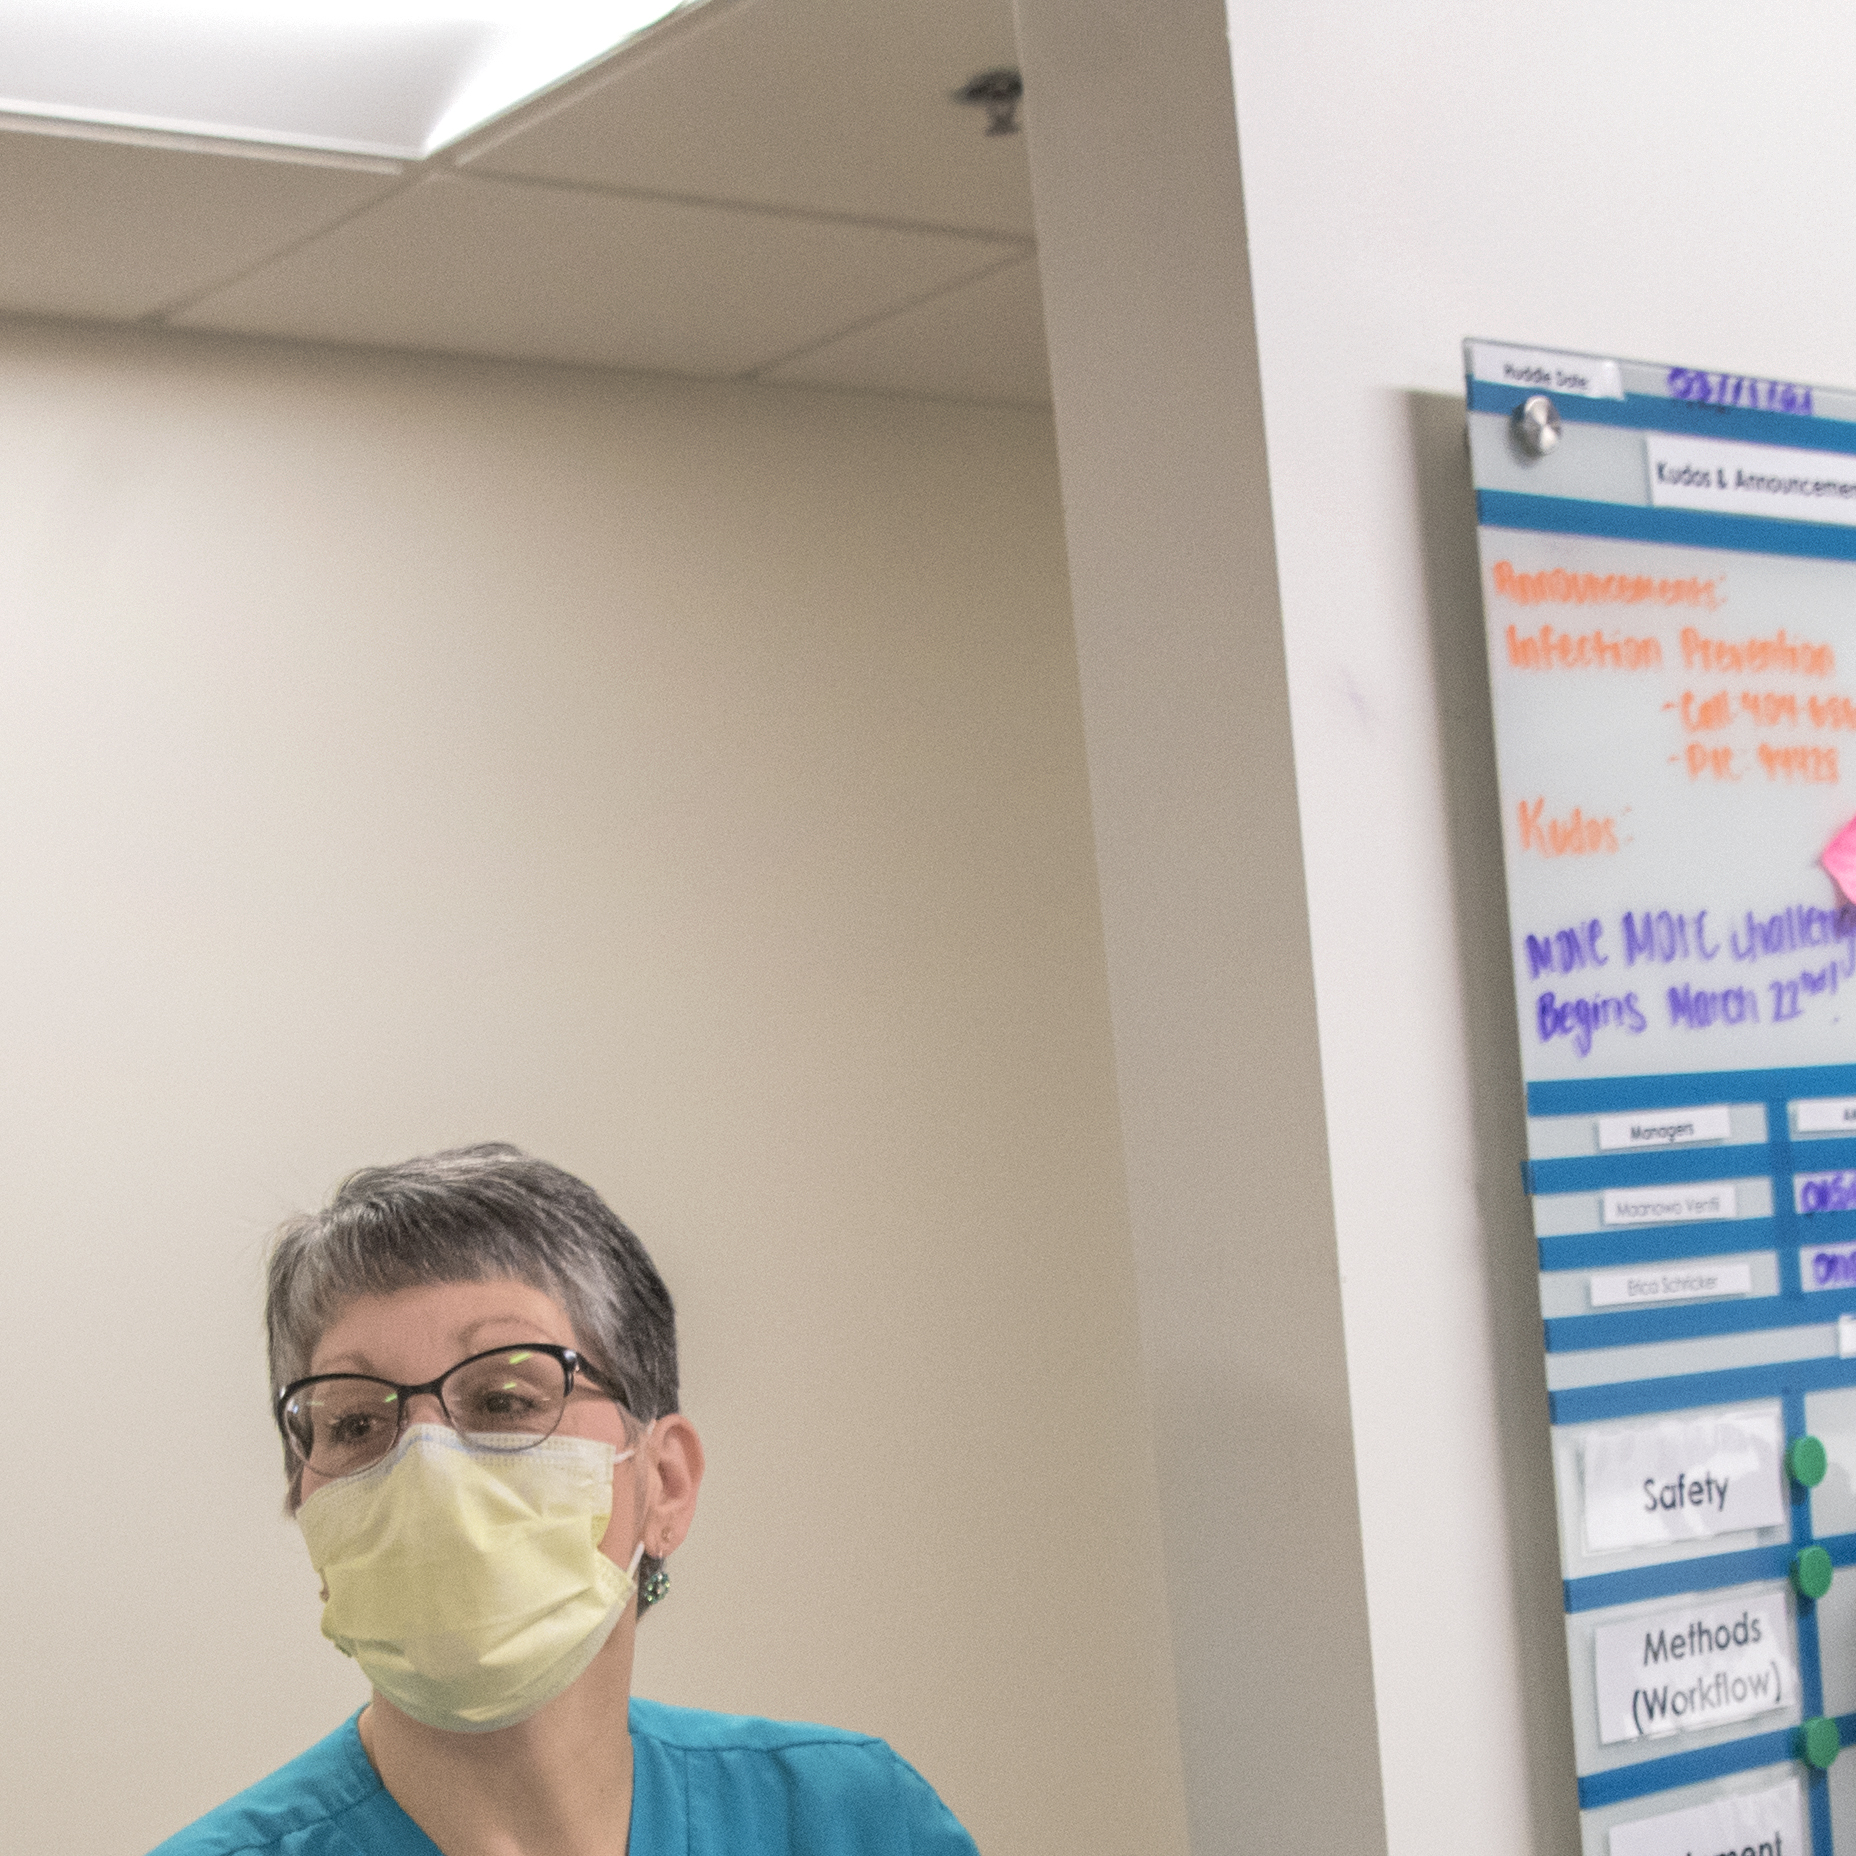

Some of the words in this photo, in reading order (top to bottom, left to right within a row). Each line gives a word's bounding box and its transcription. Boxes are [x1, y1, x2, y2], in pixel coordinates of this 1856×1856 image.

[1656, 459, 1712, 490] Kudos
[1717, 469, 1729, 490] &
[1536, 986, 1647, 1057] Begins
[1668, 983, 1760, 1028] March
[1630, 1118, 1695, 1143] Managers
[1643, 1472, 1730, 1513] Safety
[1643, 1610, 1763, 1668] Methods
[1632, 1660, 1783, 1735] (Workflow)
